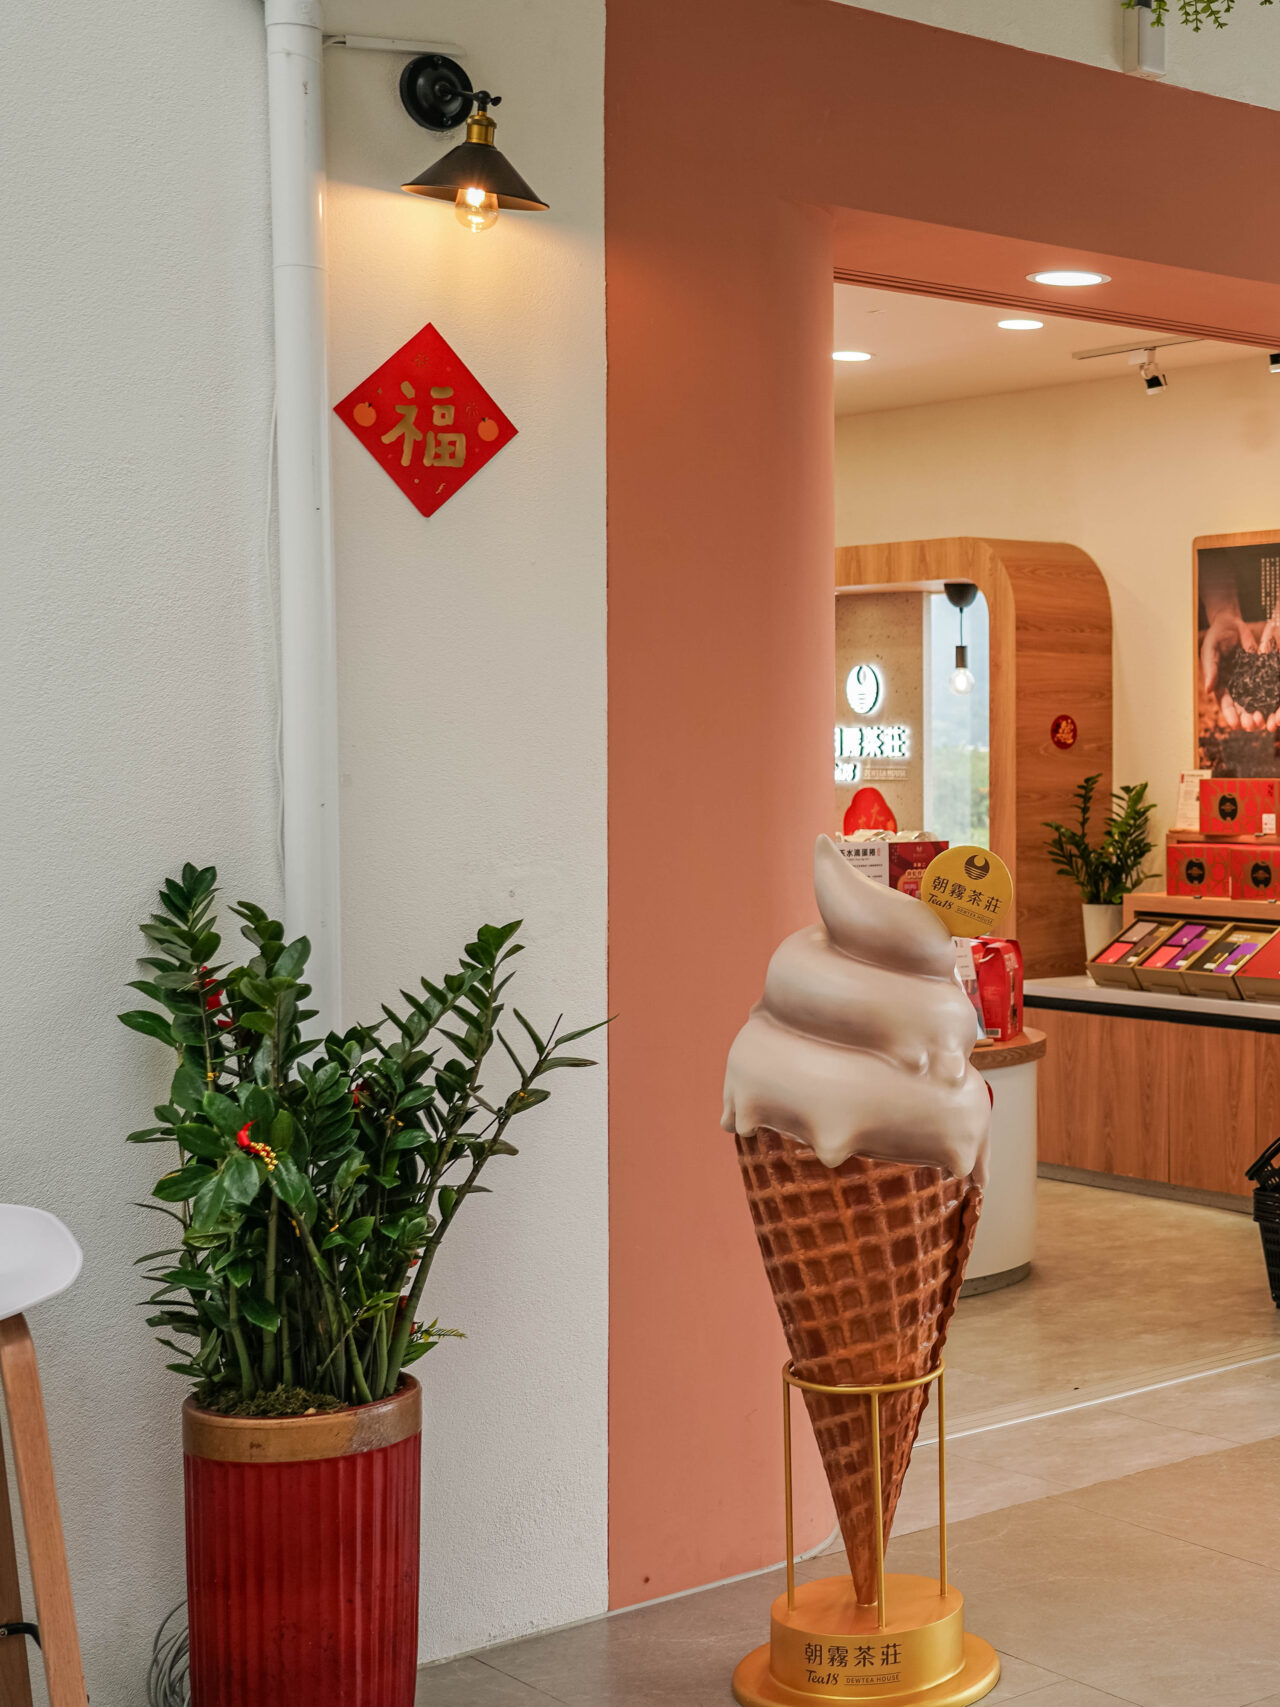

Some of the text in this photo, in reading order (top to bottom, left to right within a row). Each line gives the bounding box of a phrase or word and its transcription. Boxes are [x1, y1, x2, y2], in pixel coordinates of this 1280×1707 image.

[380, 380, 467, 468] 福
[927, 893, 954, 910] Tea18
[932, 877, 1002, 912] 朝霧茶莊
[804, 1642, 903, 1668] 朝霧茶莊
[805, 1669, 840, 1686] Tea18
[846, 1673, 900, 1684] DEWTEA HOUSE
